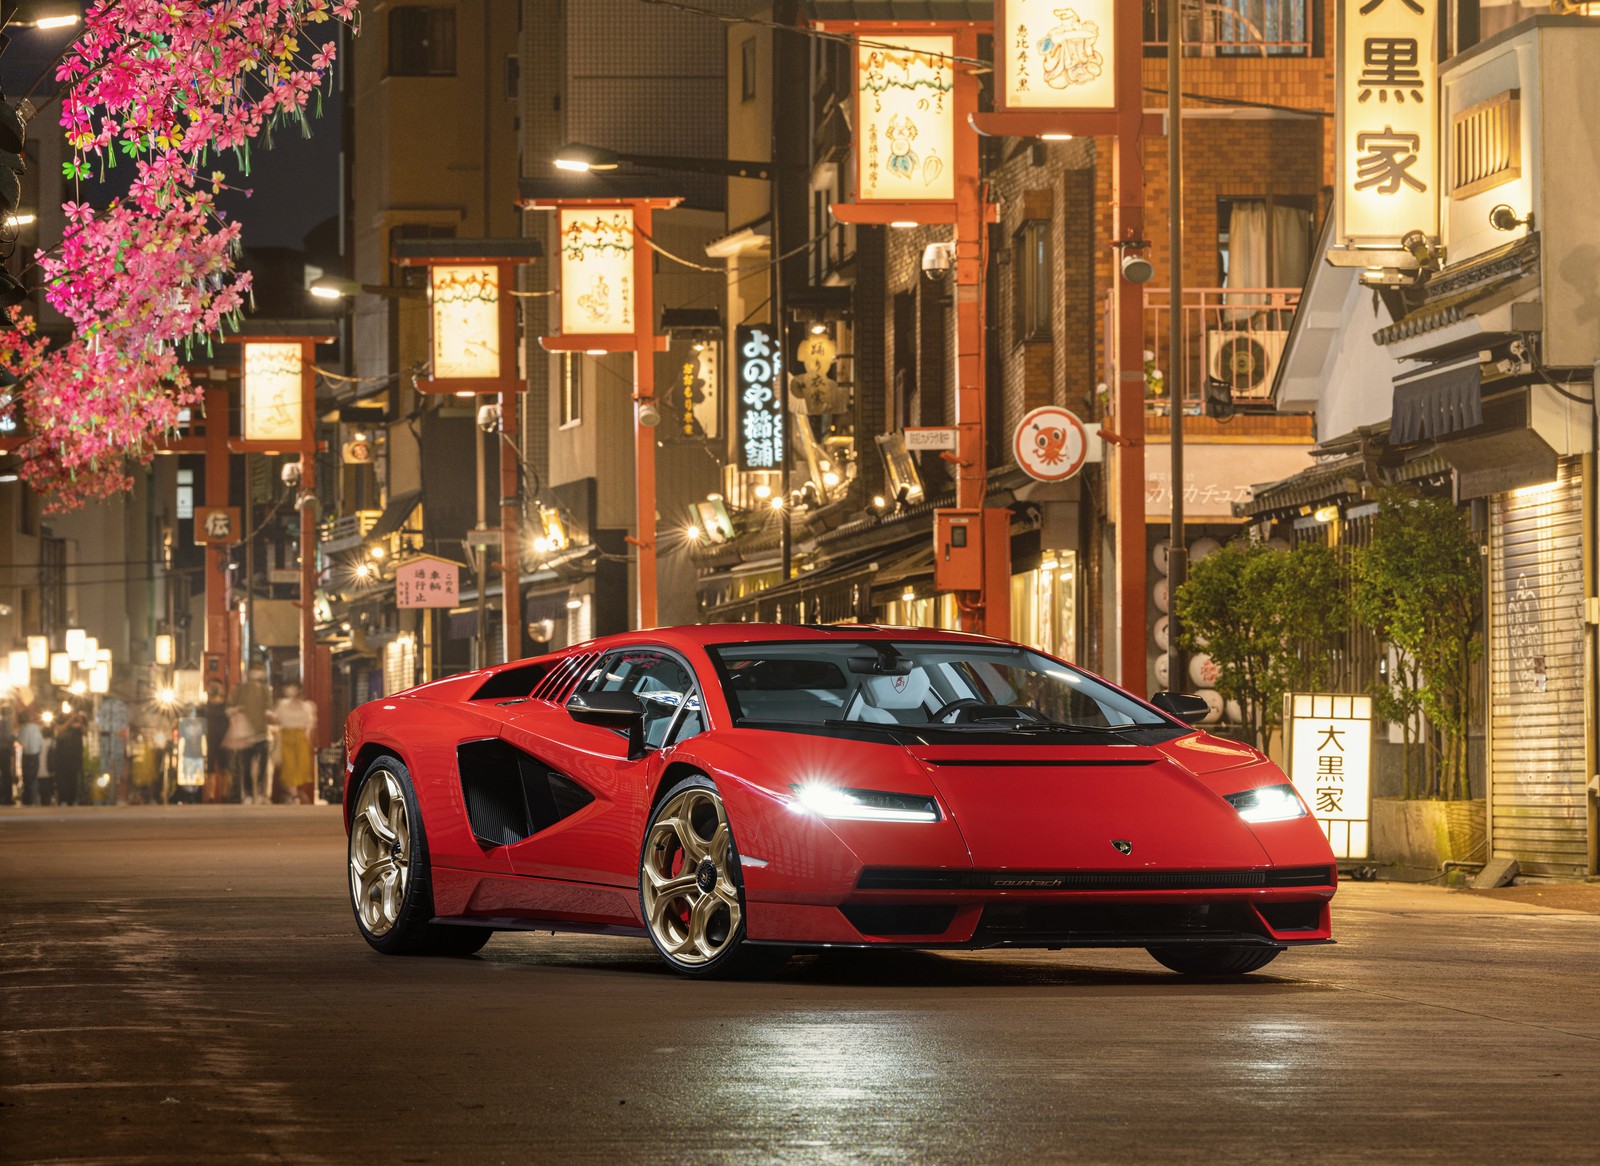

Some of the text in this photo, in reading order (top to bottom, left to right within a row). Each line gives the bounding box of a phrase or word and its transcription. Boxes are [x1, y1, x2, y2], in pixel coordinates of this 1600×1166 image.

[205, 511, 230, 537] 伝
[1316, 725, 1346, 812] 大黒家
